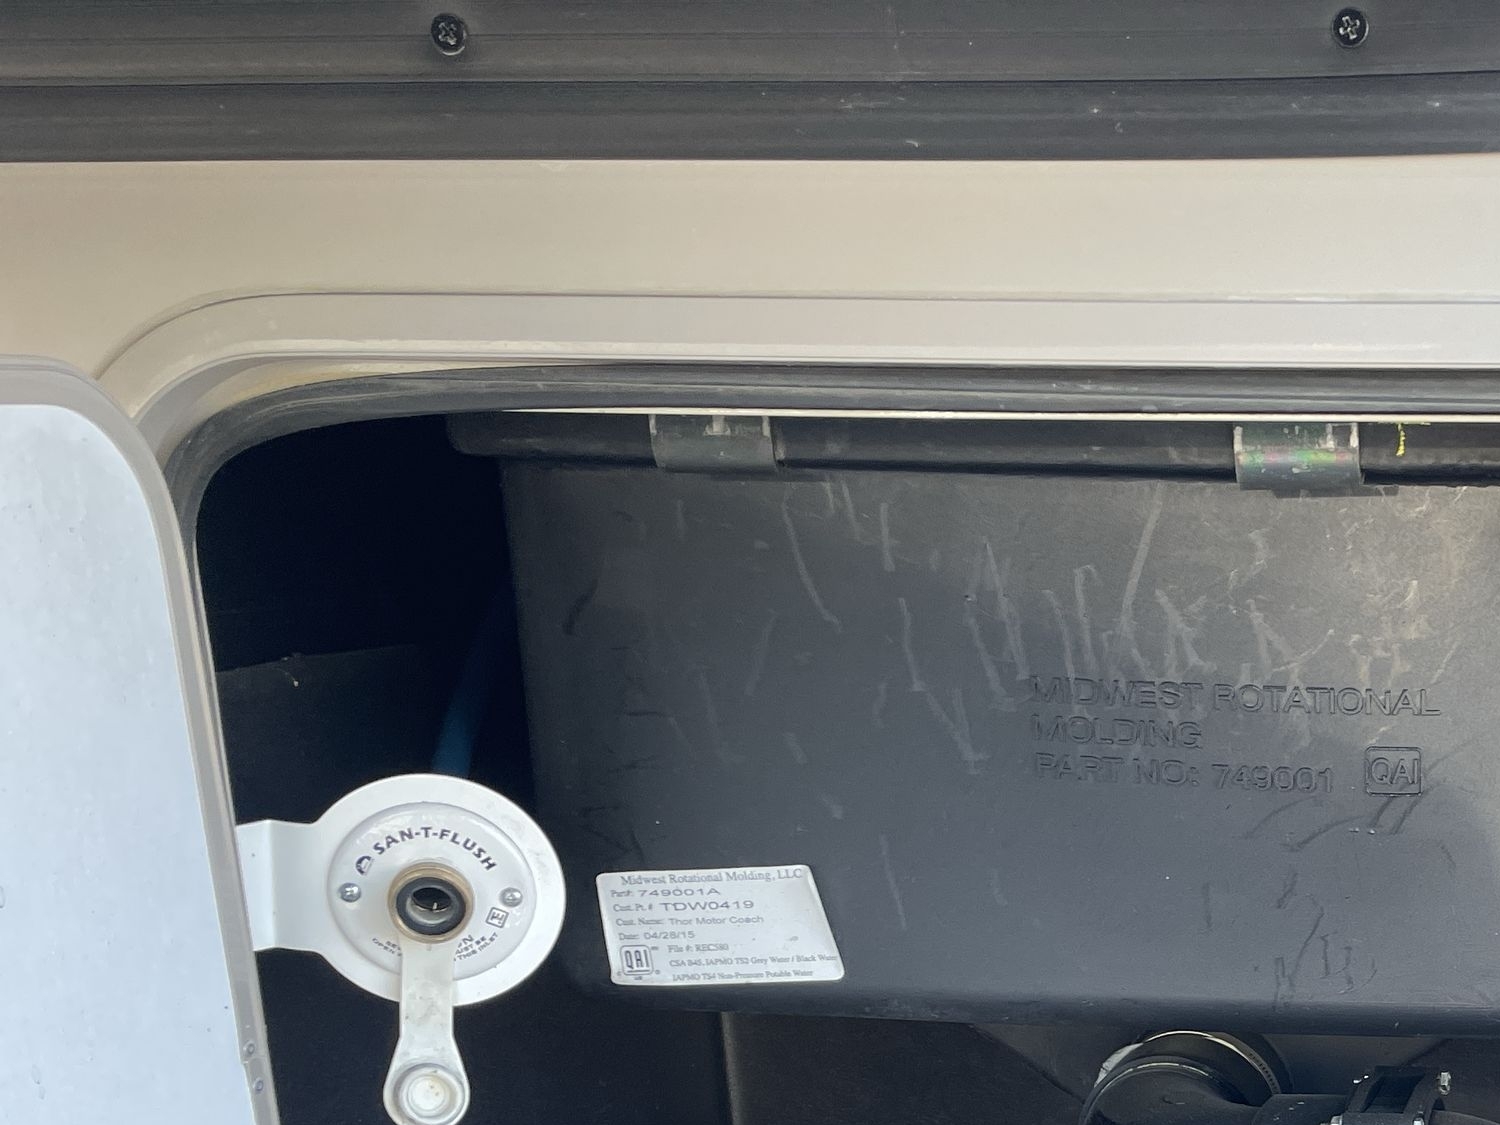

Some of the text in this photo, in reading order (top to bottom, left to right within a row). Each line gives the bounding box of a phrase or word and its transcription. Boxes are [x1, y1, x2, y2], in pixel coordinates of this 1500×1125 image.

[1031, 676, 1441, 716] MIDWEST ROTATIONAL
[1032, 714, 1202, 749] MOLDING
[1036, 752, 1334, 793] PART NO: 749001
[373, 826, 497, 870] SAN-T-FLUSH
[620, 868, 804, 886] Midwest Rotational Molding, LLC
[639, 887, 721, 897] 749001A
[659, 900, 755, 912] TDW0419
[668, 917, 693, 926] Thor
[695, 917, 726, 925] Motor
[729, 915, 765, 925] Coach
[643, 931, 696, 940] 04/28/15
